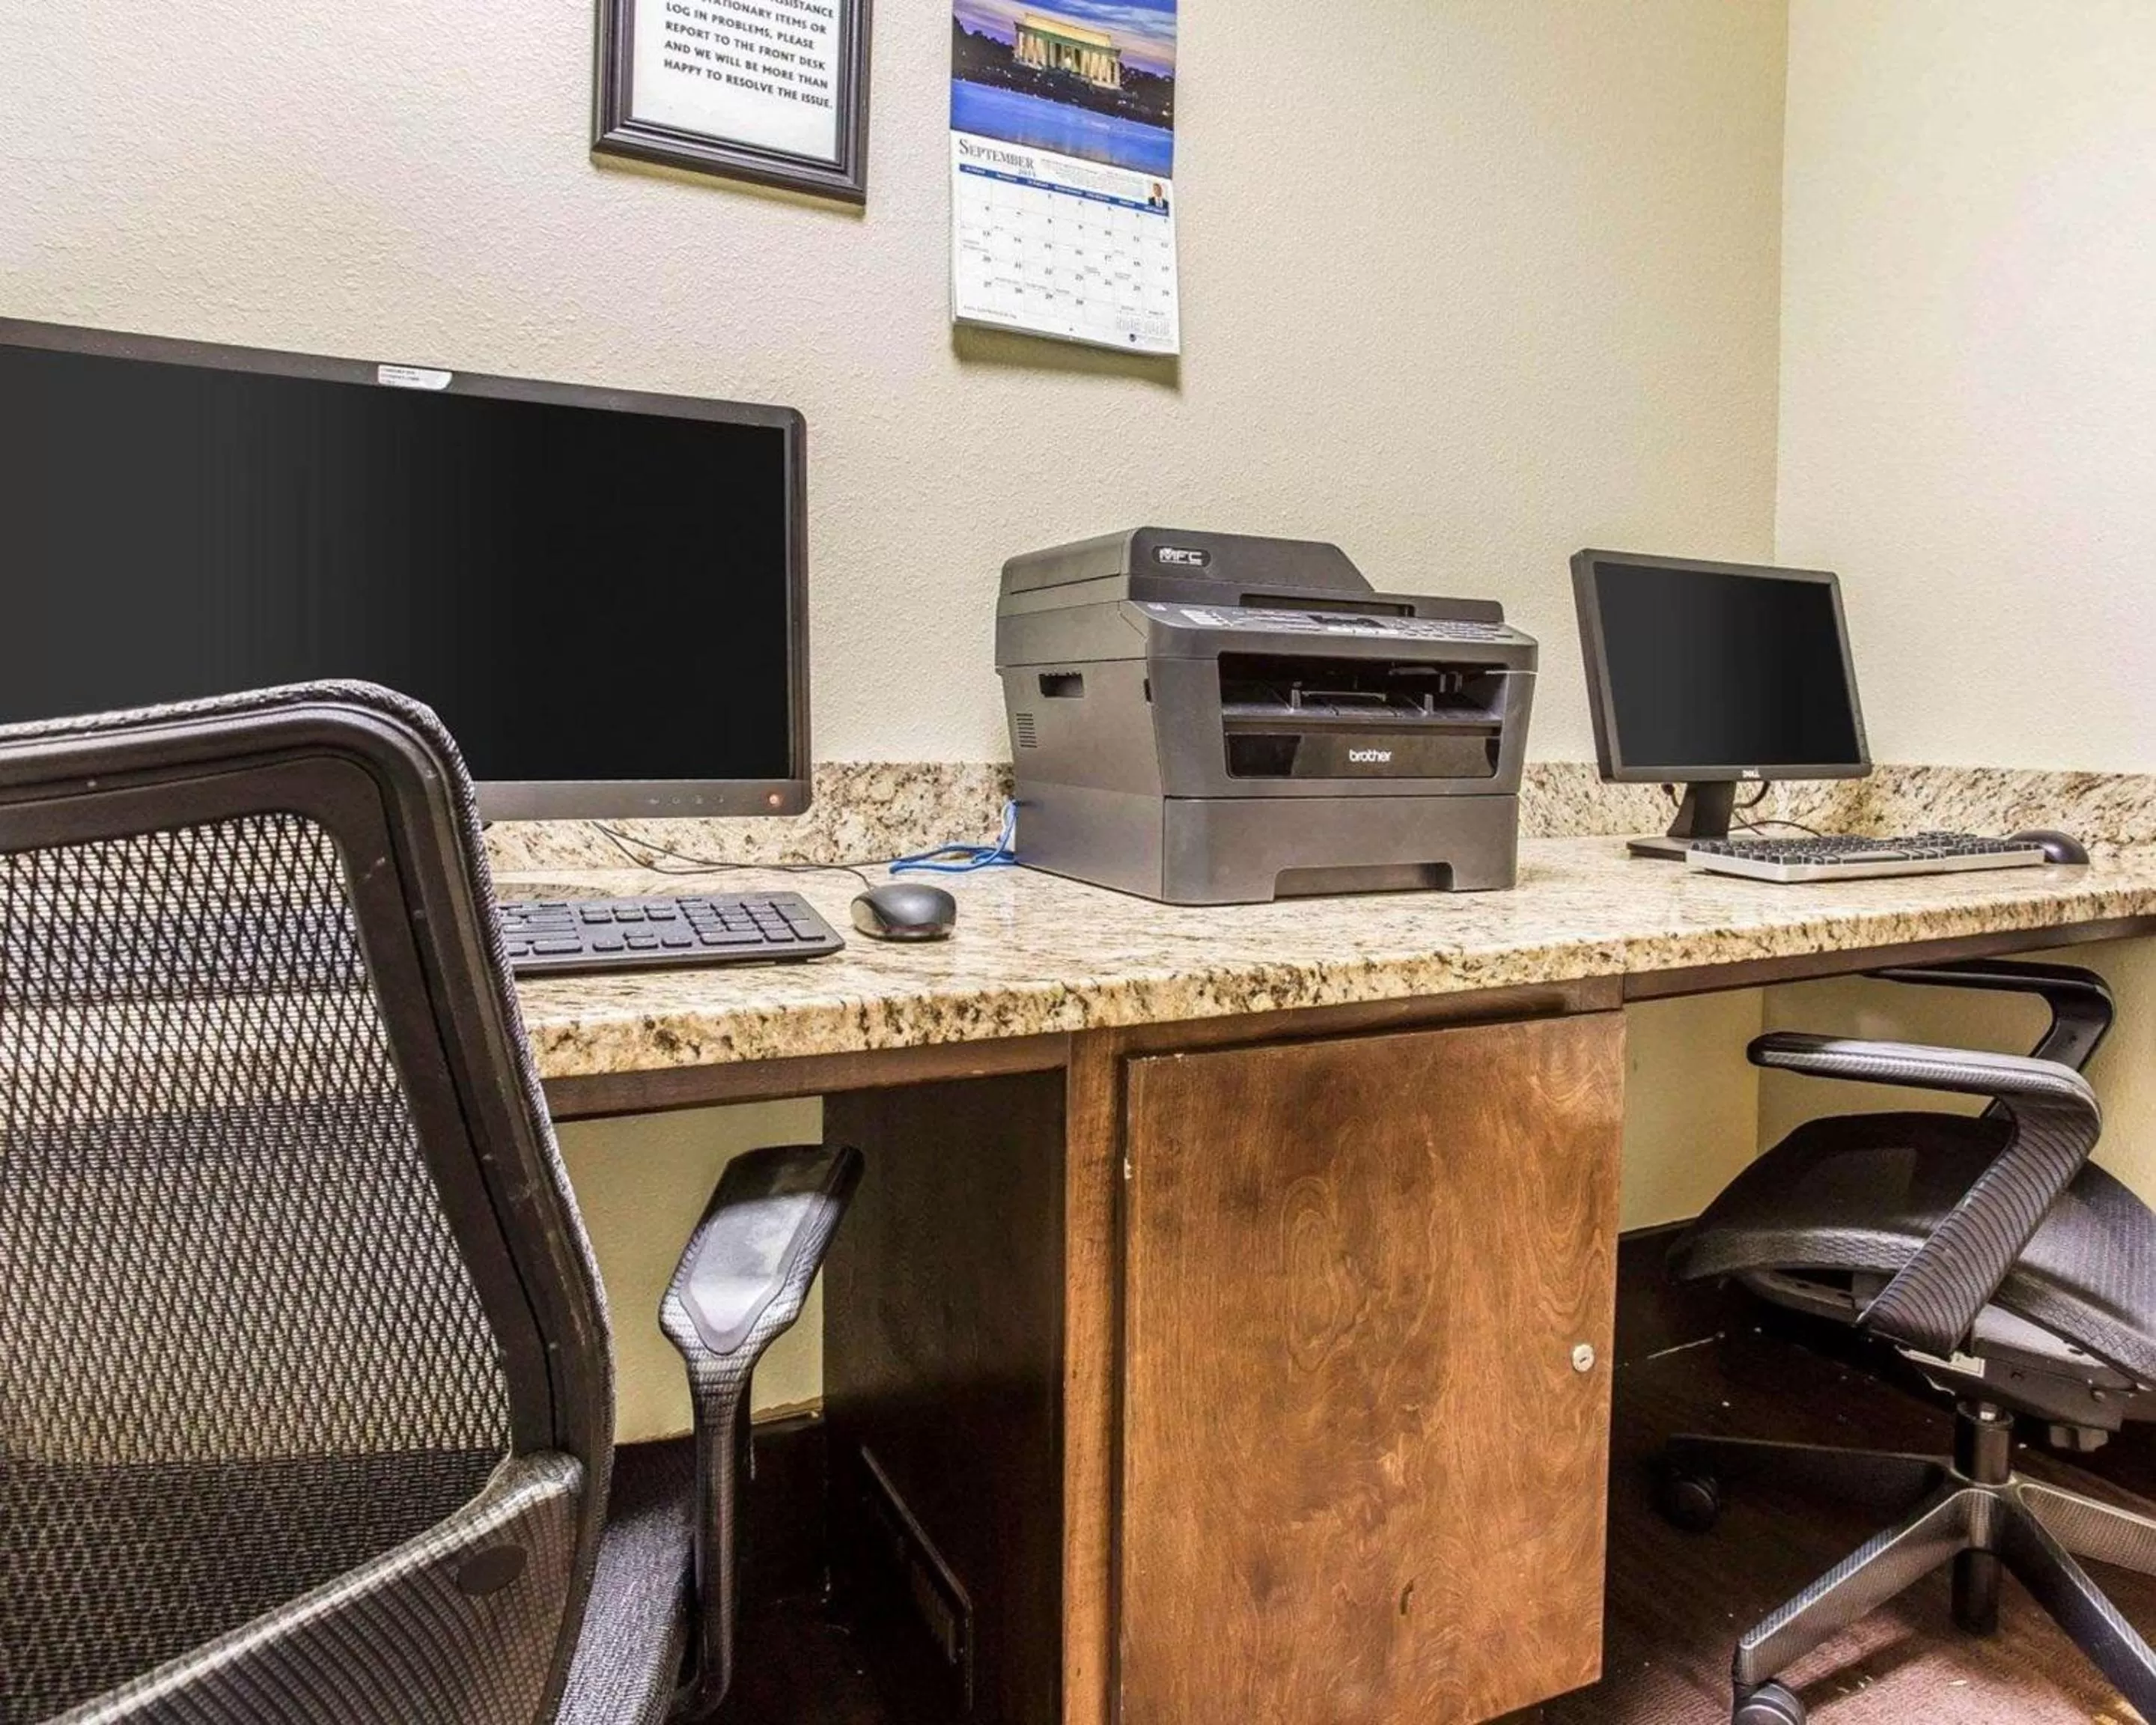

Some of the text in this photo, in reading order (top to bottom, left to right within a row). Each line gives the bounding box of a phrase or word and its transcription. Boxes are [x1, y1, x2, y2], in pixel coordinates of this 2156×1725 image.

[666, 2, 814, 49] LOG IN PROBLEMS, PLEASE
[701, 0, 827, 34] ATIONARY ITEMS OR
[772, 0, 833, 18] SSISTANCE
[664, 40, 829, 90] AND WE WILL BE MORE THAN
[665, 21, 826, 70] REPORT TO THE FRONT DESK
[664, 58, 833, 109] HAPPY TO RESOLVE THE ISSUE.
[1159, 547, 1202, 565] MFC
[1349, 749, 1392, 762] brother
